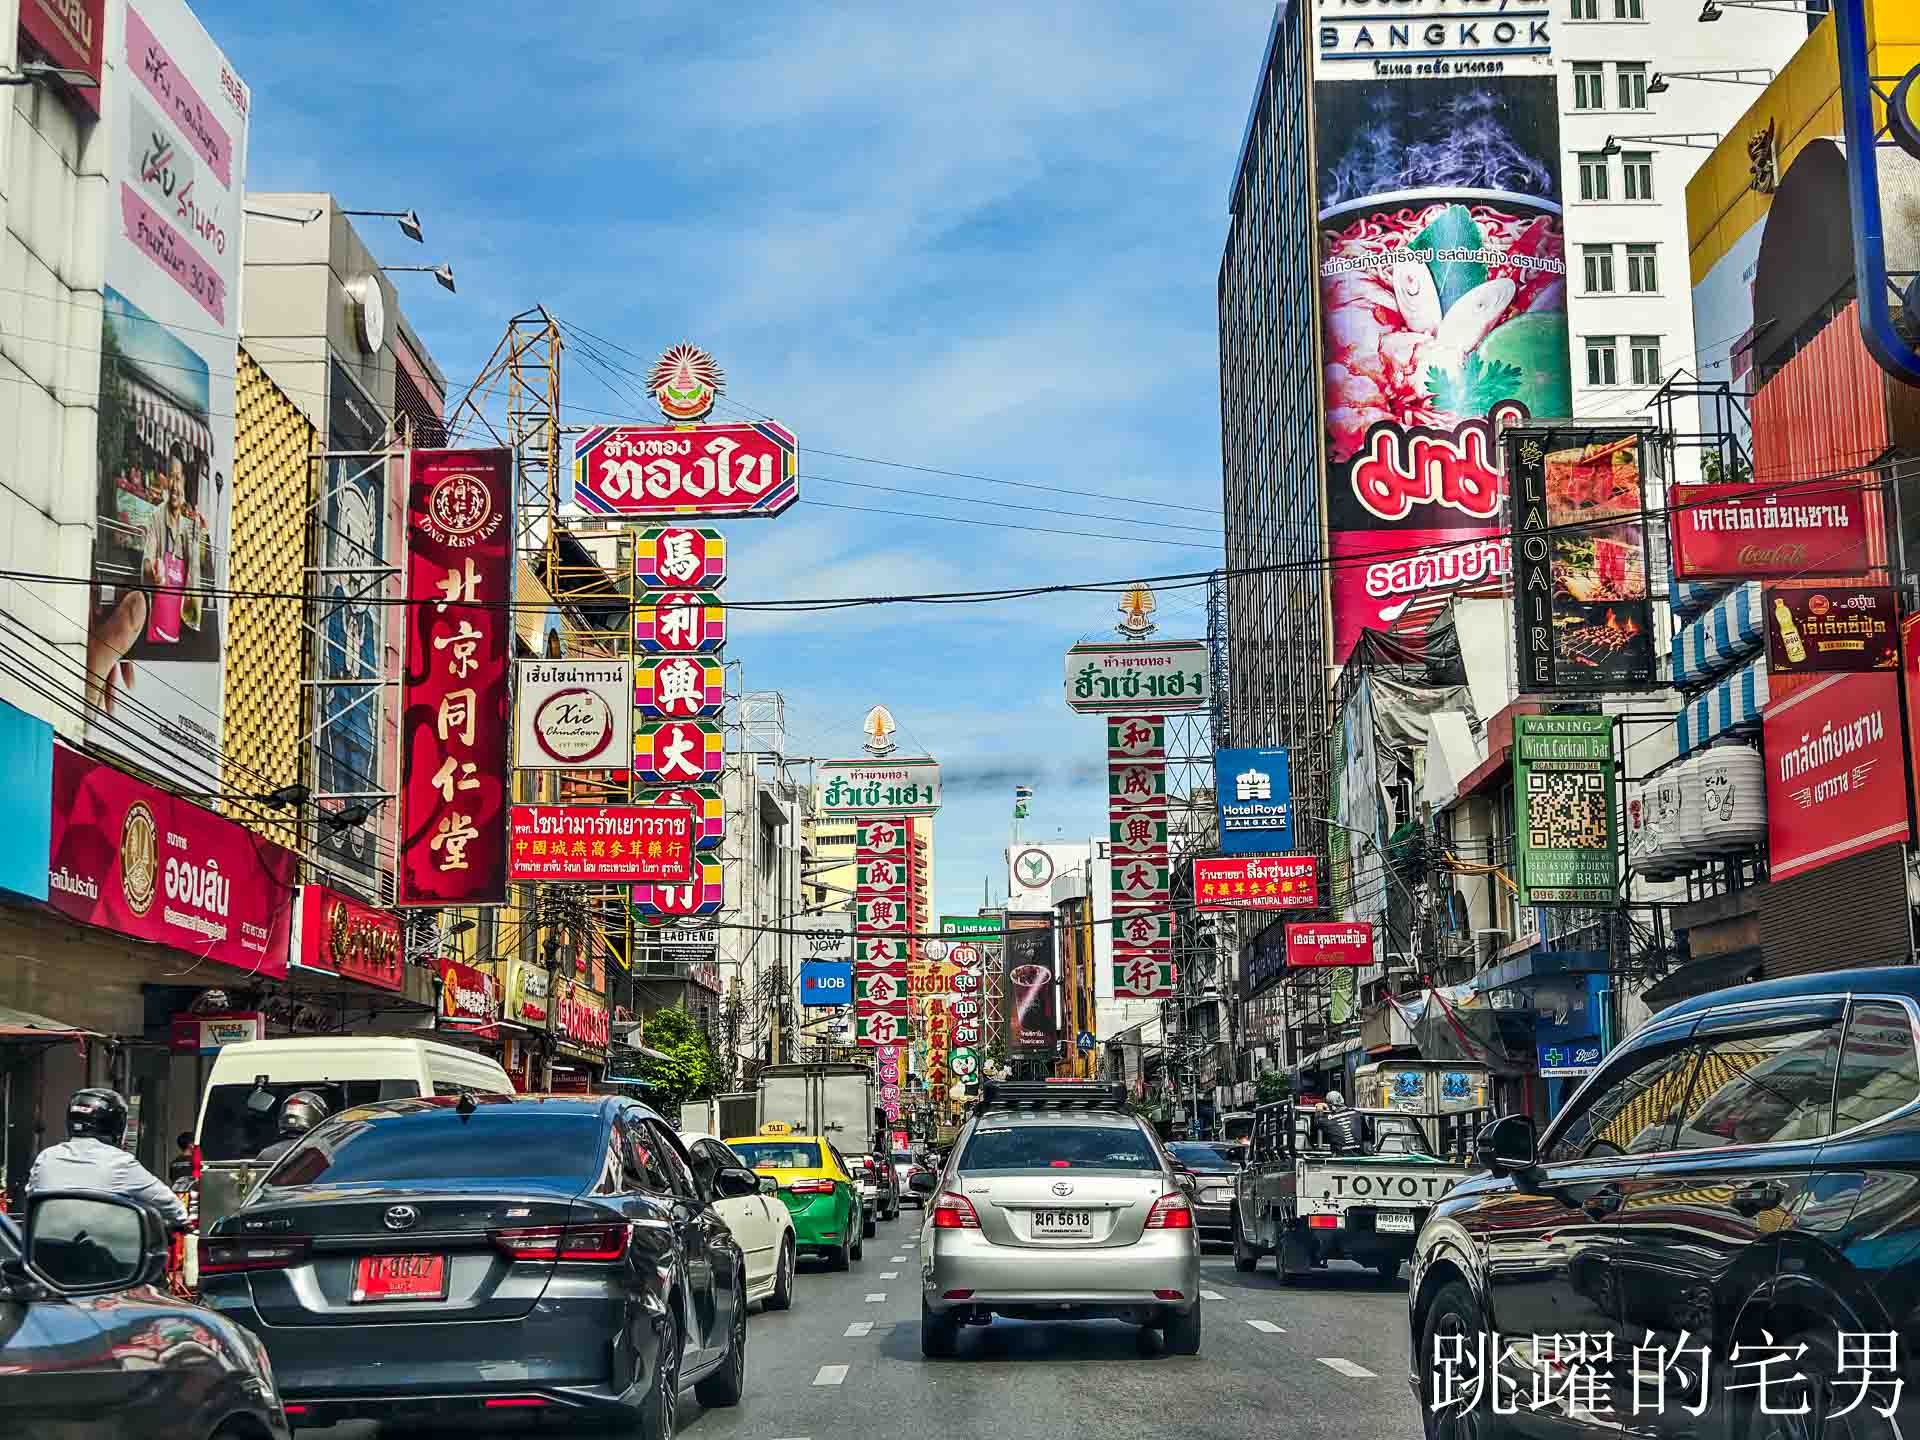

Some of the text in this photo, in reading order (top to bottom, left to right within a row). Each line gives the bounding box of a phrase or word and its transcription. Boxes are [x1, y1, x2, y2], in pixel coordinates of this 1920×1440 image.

[1320, 20, 1550, 48] BANGKOK
[419, 512, 504, 548] TONG REN TANG
[430, 558, 485, 872] 北京同仁堂
[555, 703, 594, 725] Xie
[545, 726, 601, 736] Chinatown
[1527, 721, 1591, 732] WARNING
[1780, 710, 1884, 782] เกาลัดเทียนชาน
[1814, 770, 1849, 804] เยาวราช
[1223, 803, 1287, 816] Hotel Royal
[529, 808, 686, 836] ไชน่ามาร์ทเยาวราช
[1225, 819, 1287, 827] BANGKOK
[1123, 722, 1156, 991] 和成興大金行
[164, 858, 231, 917] ออมสิน
[1531, 872, 1610, 885] IN THE BREW
[1252, 896, 1281, 905] NATURAL
[804, 929, 845, 940] GOLD
[868, 825, 896, 1042] 和成興大金行
[809, 940, 841, 951] NOW
[818, 977, 845, 989] UOB
[768, 1123, 785, 1132] TAXI
[1332, 1175, 1457, 1197] TOYOTA
[1058, 1212, 1090, 1226] 5618
